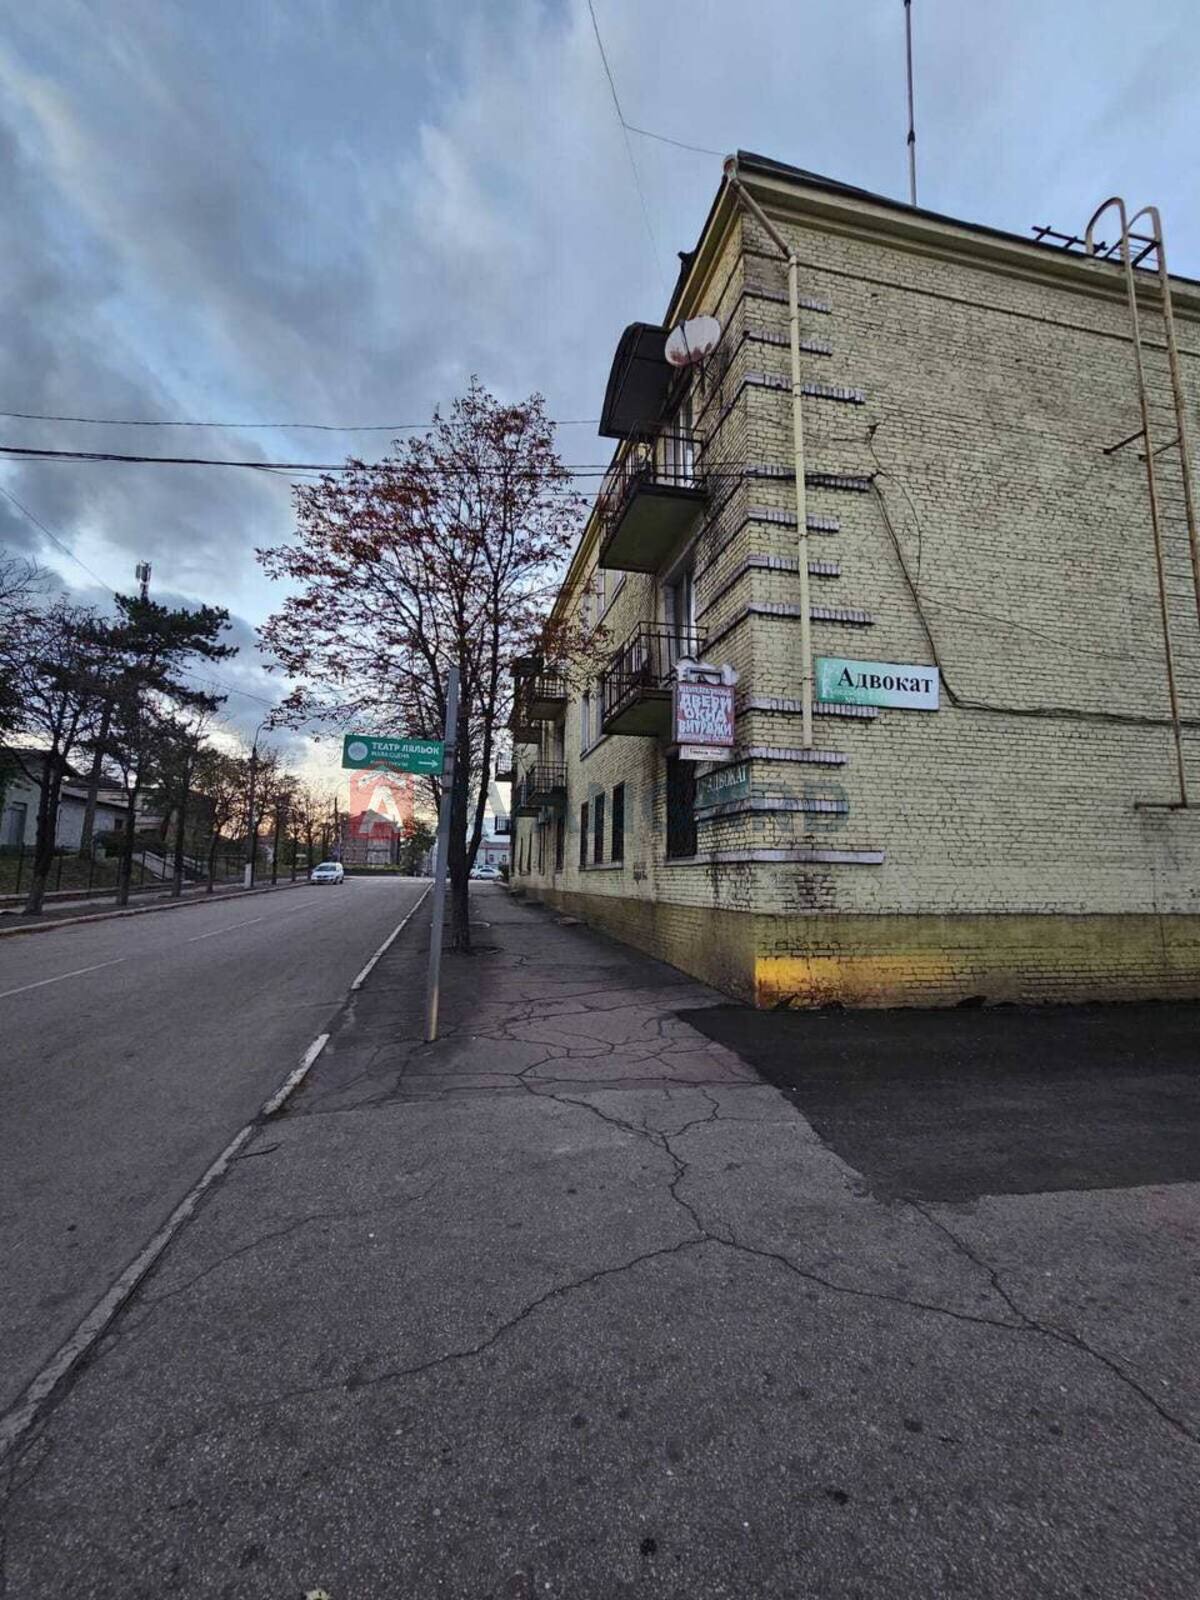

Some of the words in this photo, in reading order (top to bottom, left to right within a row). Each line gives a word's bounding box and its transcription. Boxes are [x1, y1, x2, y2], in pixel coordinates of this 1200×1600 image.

[837, 666, 934, 694] Адвокат
[372, 743, 400, 752] ТЕАТР
[401, 744, 440, 755] ЛЯЛЬОК
